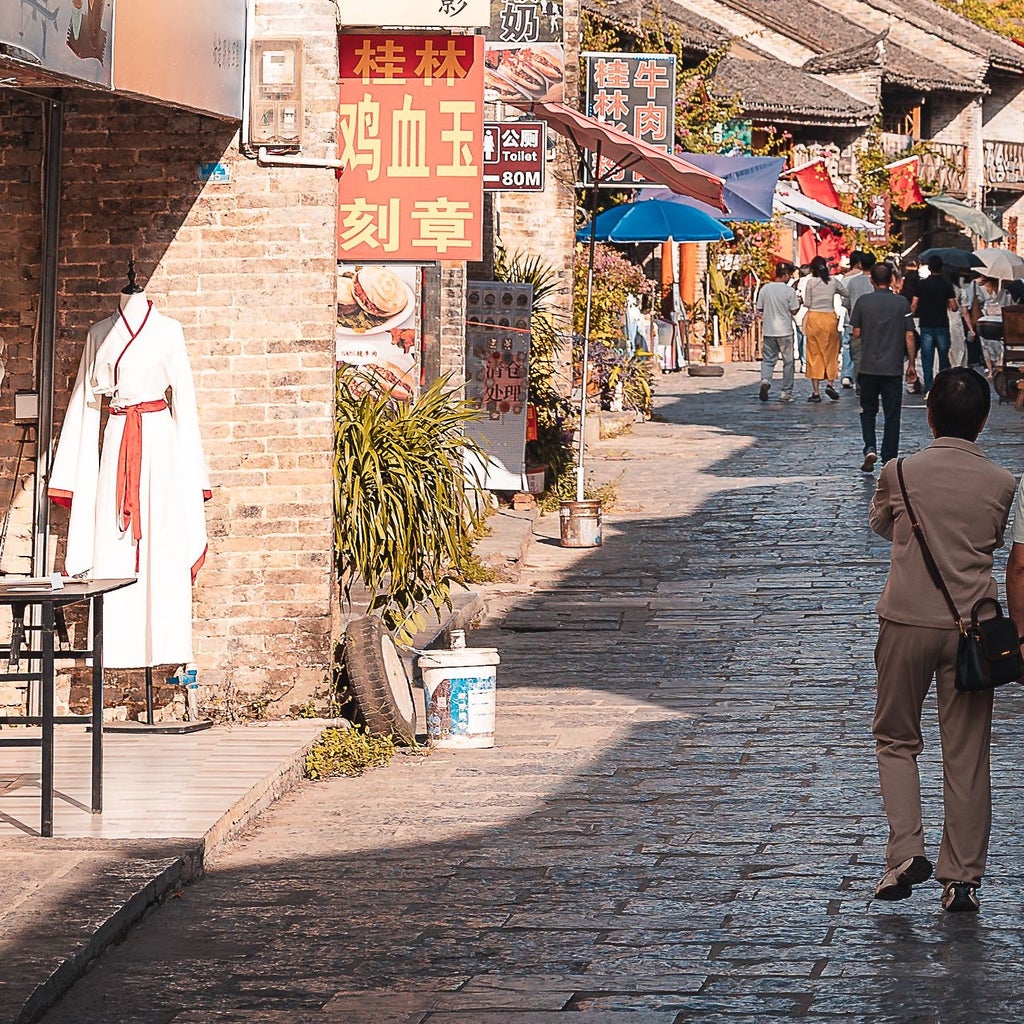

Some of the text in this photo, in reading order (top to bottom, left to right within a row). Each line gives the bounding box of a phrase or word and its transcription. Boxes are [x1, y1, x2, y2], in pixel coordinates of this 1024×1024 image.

[353, 39, 468, 87] 桂林
[340, 93, 478, 183] 鸡血玉
[501, 129, 539, 148] 公厕
[593, 59, 630, 182] 桂林粉
[633, 61, 669, 182] 牛肉
[502, 150, 538, 162] Toilet
[502, 171, 541, 186] 80M
[340, 197, 473, 253] 刻章
[485, 383, 521, 403] 处理
